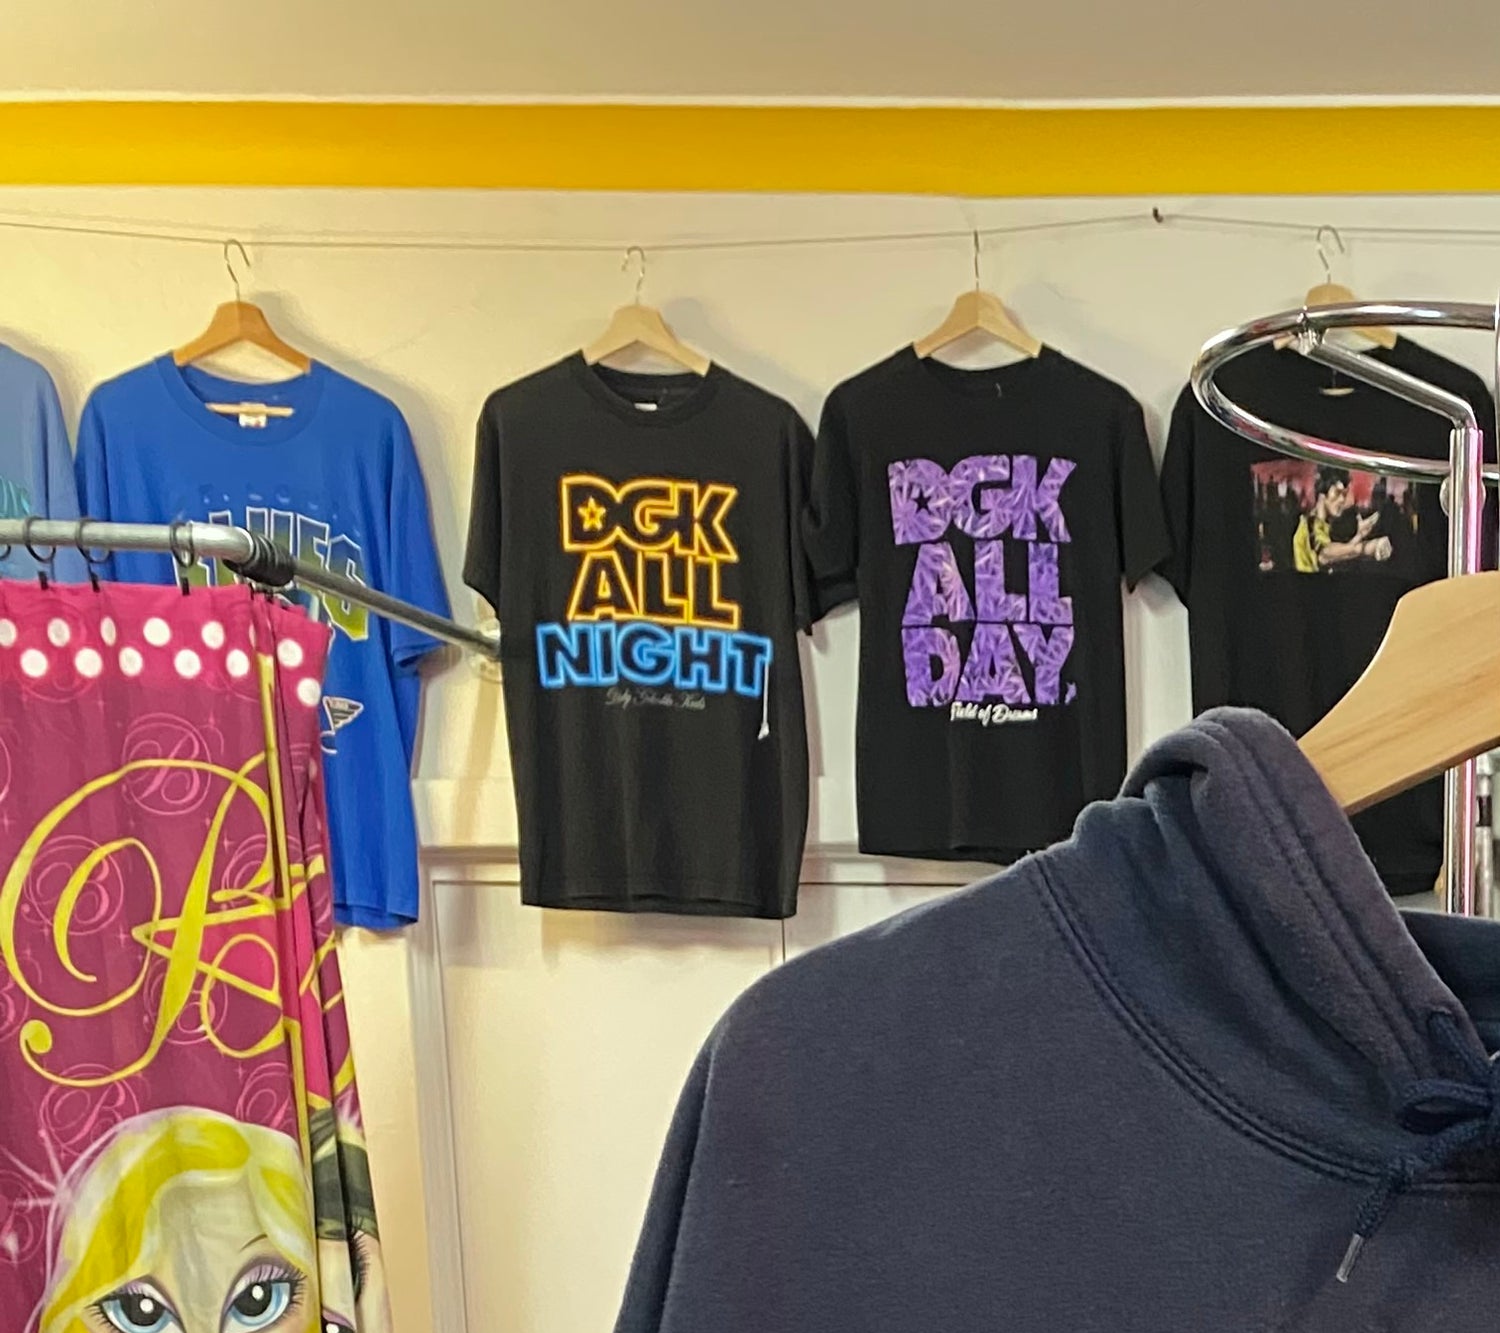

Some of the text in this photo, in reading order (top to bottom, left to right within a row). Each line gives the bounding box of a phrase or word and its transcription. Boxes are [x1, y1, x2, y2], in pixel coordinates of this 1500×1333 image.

[559, 472, 739, 562] DGK
[888, 454, 1077, 545] DGK
[566, 549, 743, 631] ALL
[902, 540, 1073, 625] ALL
[536, 621, 773, 699] NIGHT
